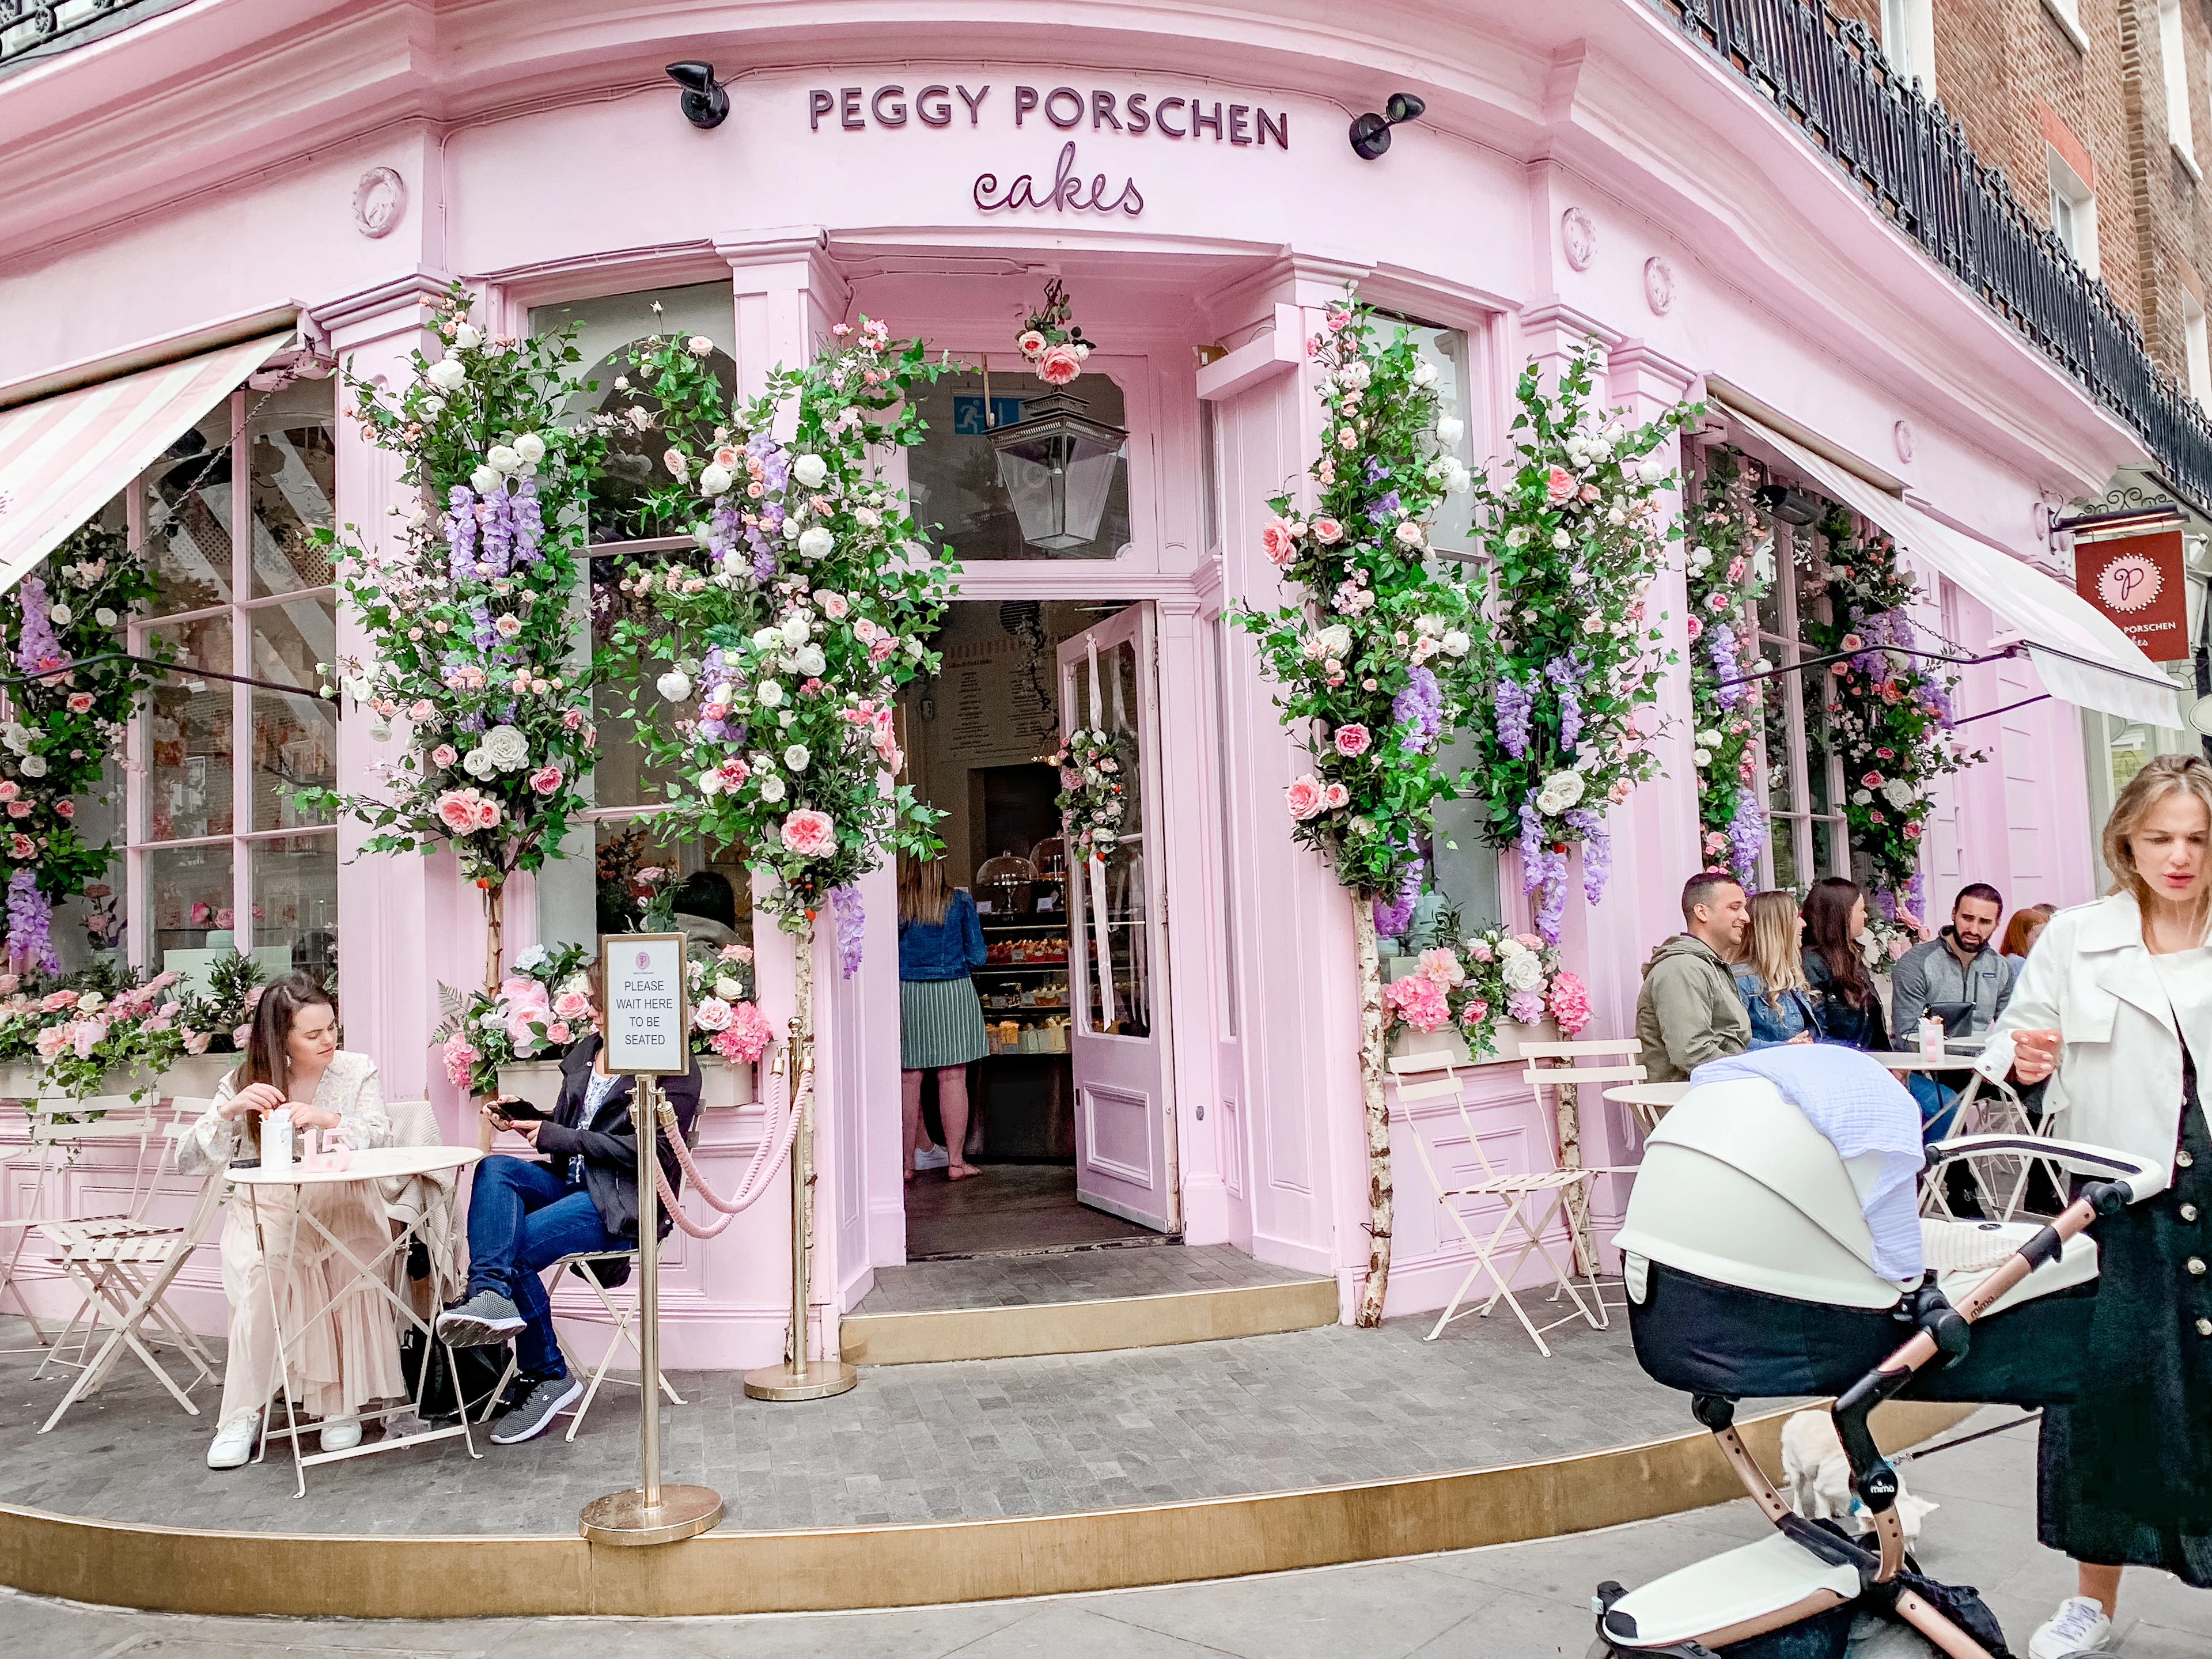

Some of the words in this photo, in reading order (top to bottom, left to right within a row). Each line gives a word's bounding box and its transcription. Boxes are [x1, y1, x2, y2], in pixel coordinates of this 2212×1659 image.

[809, 85, 990, 131] PEGGY
[1014, 85, 1289, 150] PORSCHEN
[973, 141, 1145, 215] cakes
[2123, 621, 2176, 634] PORSCHEN
[624, 980, 664, 991] PLEASE
[616, 998, 642, 1009] WAIT
[645, 998, 673, 1009] HERE
[630, 1017, 643, 1027] TO
[646, 1016, 660, 1027] BE
[625, 1035, 665, 1045] SEATED
[297, 1127, 351, 1172] 15
[1971, 1296, 1994, 1319] mima
[1870, 1481, 1895, 1494] mima
